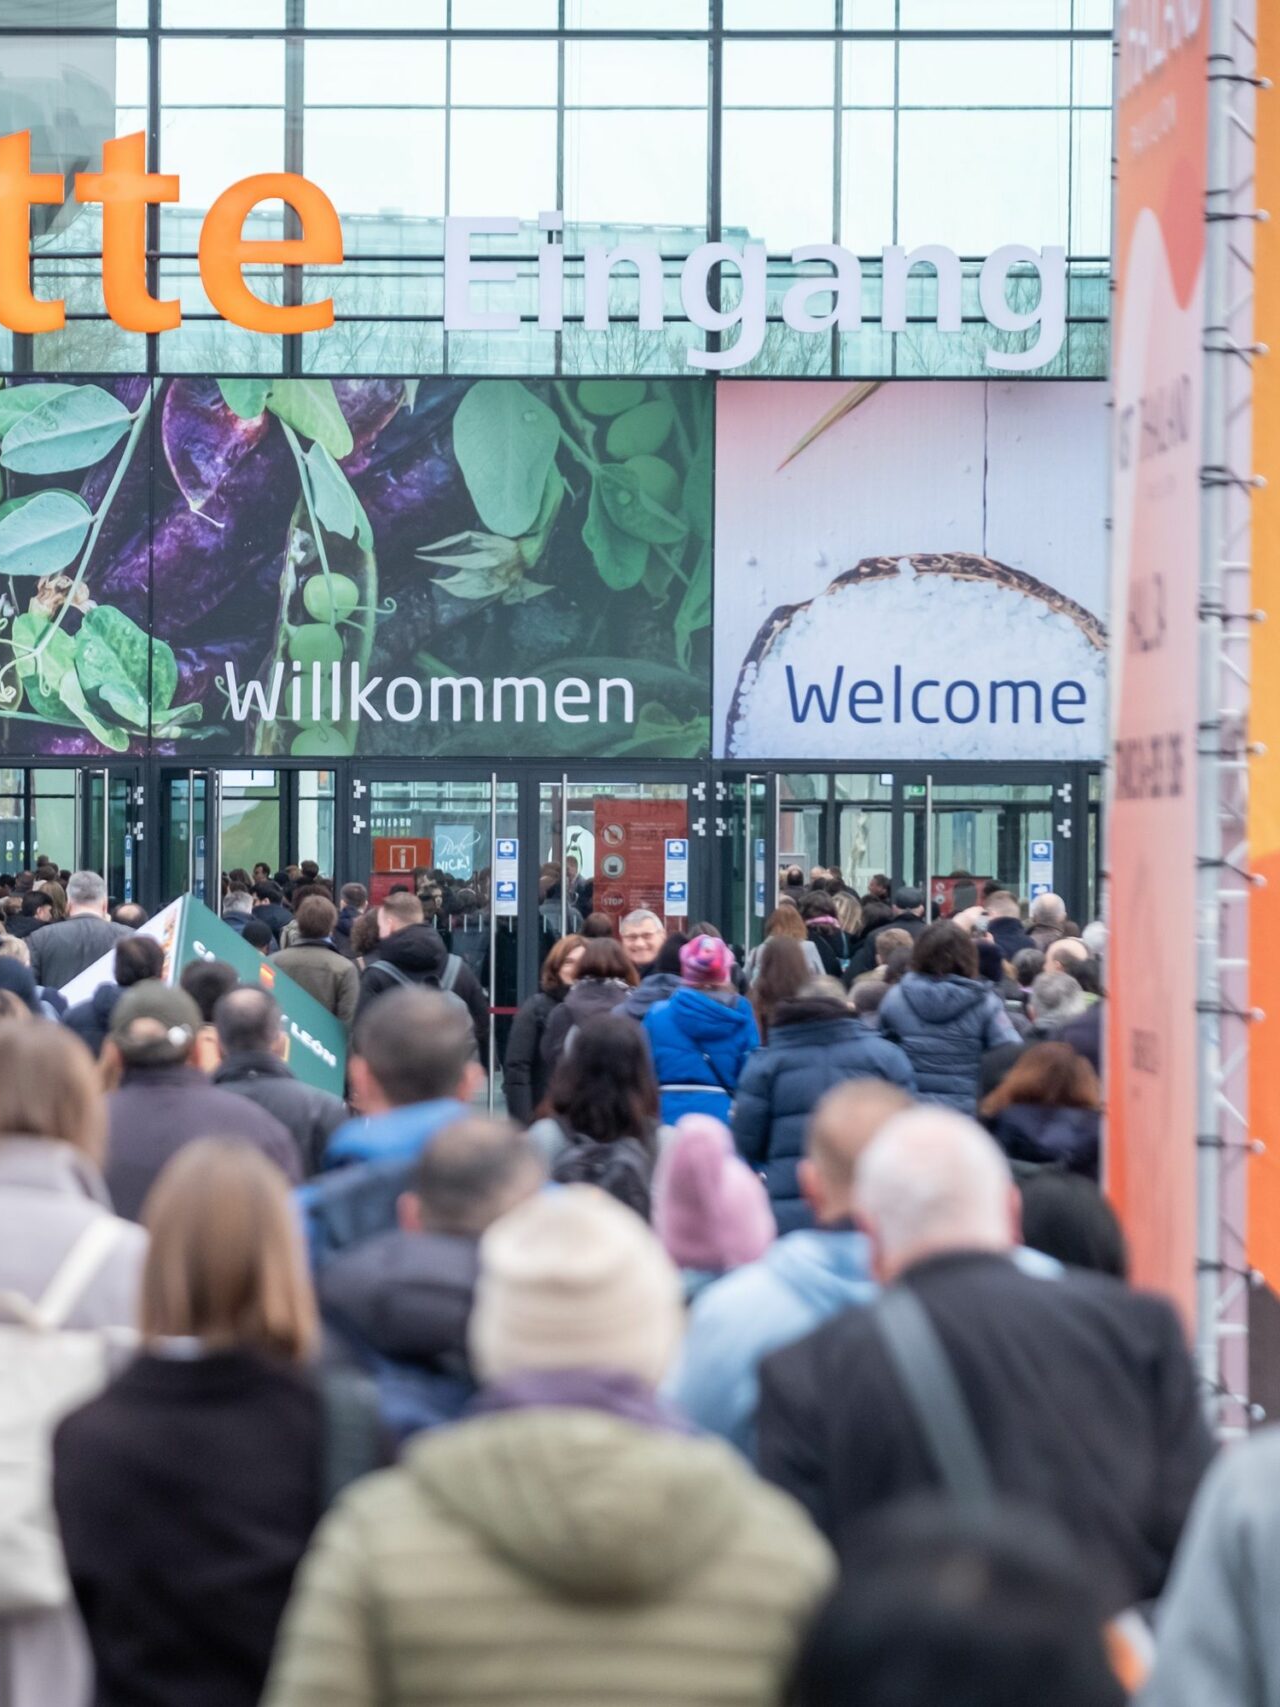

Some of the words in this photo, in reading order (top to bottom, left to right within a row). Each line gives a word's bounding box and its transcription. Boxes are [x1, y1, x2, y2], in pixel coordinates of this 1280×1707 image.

[443, 210, 1067, 372] Eingang
[225, 661, 634, 723] Willkommen
[785, 665, 1087, 724] Welcome
[436, 856, 471, 873] NICK!
